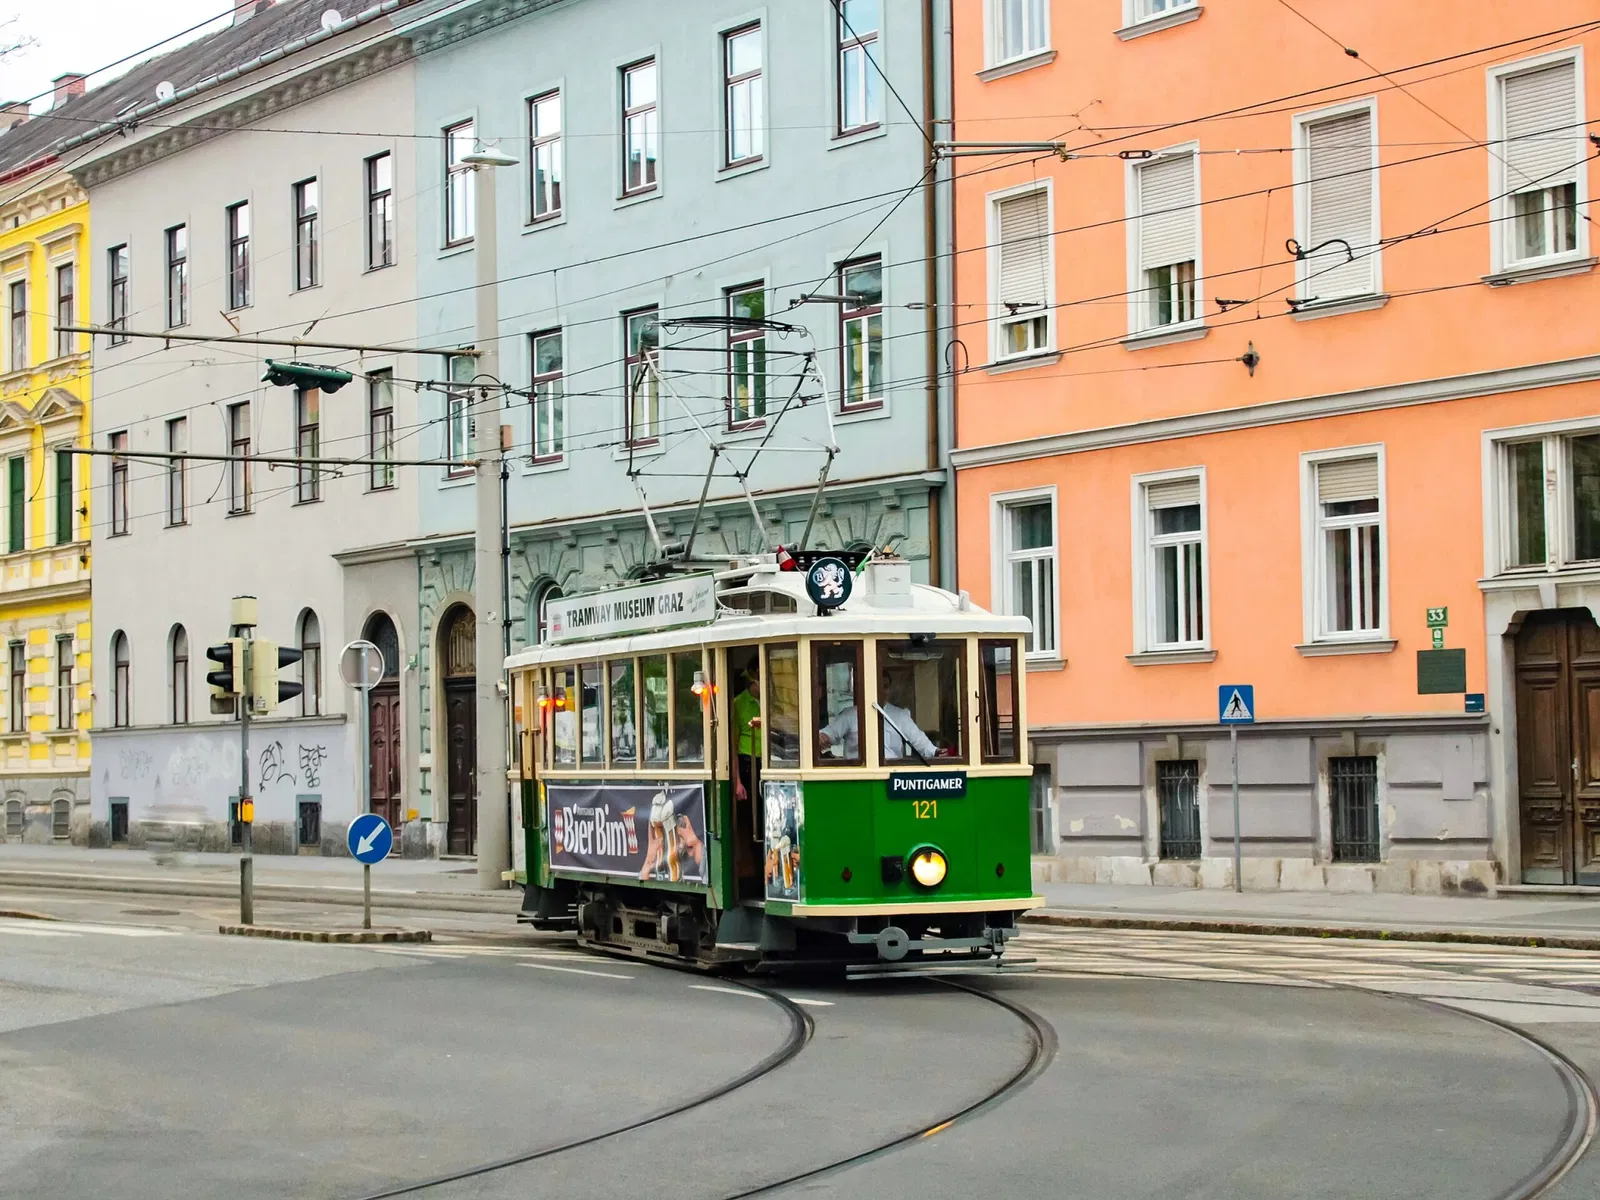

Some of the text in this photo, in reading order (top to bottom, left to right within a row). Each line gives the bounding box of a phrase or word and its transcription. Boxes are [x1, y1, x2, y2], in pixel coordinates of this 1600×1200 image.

[566, 603, 611, 628] TRAMWAY
[613, 596, 656, 621] MUSEUM
[658, 592, 684, 615] GRAZ
[1428, 608, 1444, 621] 33
[893, 777, 963, 791] PUNTIGAMER
[912, 800, 937, 819] 121
